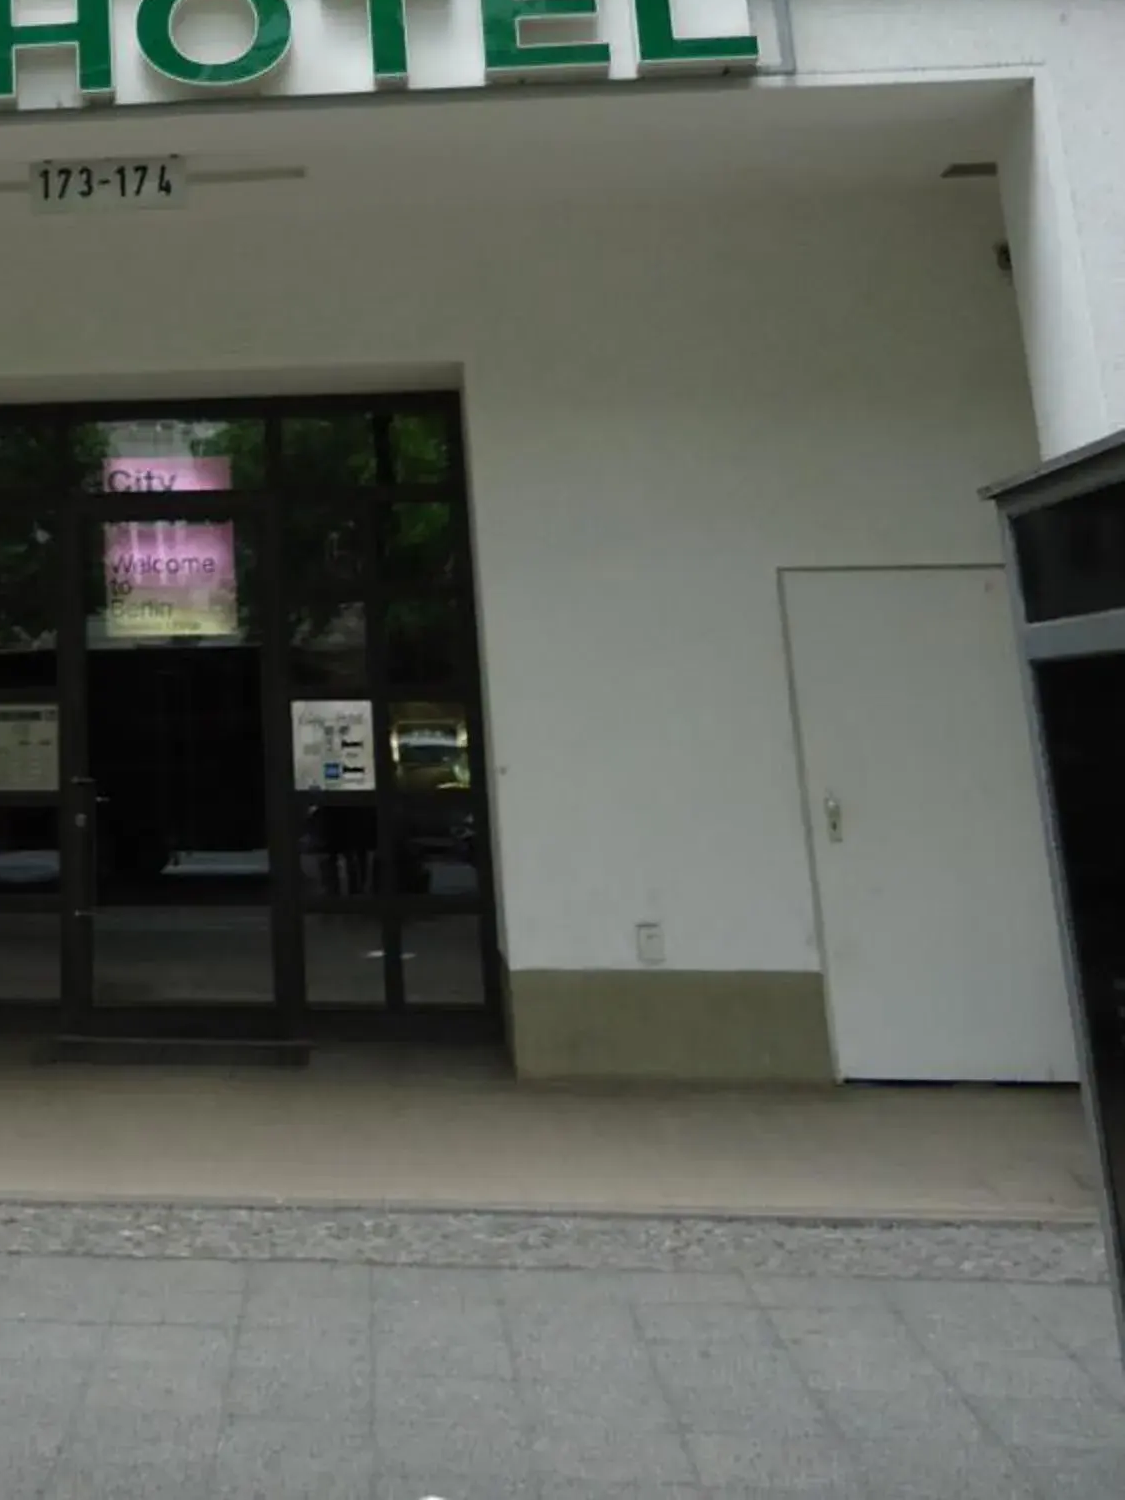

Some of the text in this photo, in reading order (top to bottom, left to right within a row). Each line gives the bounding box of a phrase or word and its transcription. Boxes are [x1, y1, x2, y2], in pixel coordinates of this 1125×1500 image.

[39, 164, 172, 200] 173-174
[108, 470, 177, 492] City
[113, 553, 216, 574] Welcome
[110, 579, 132, 595] to
